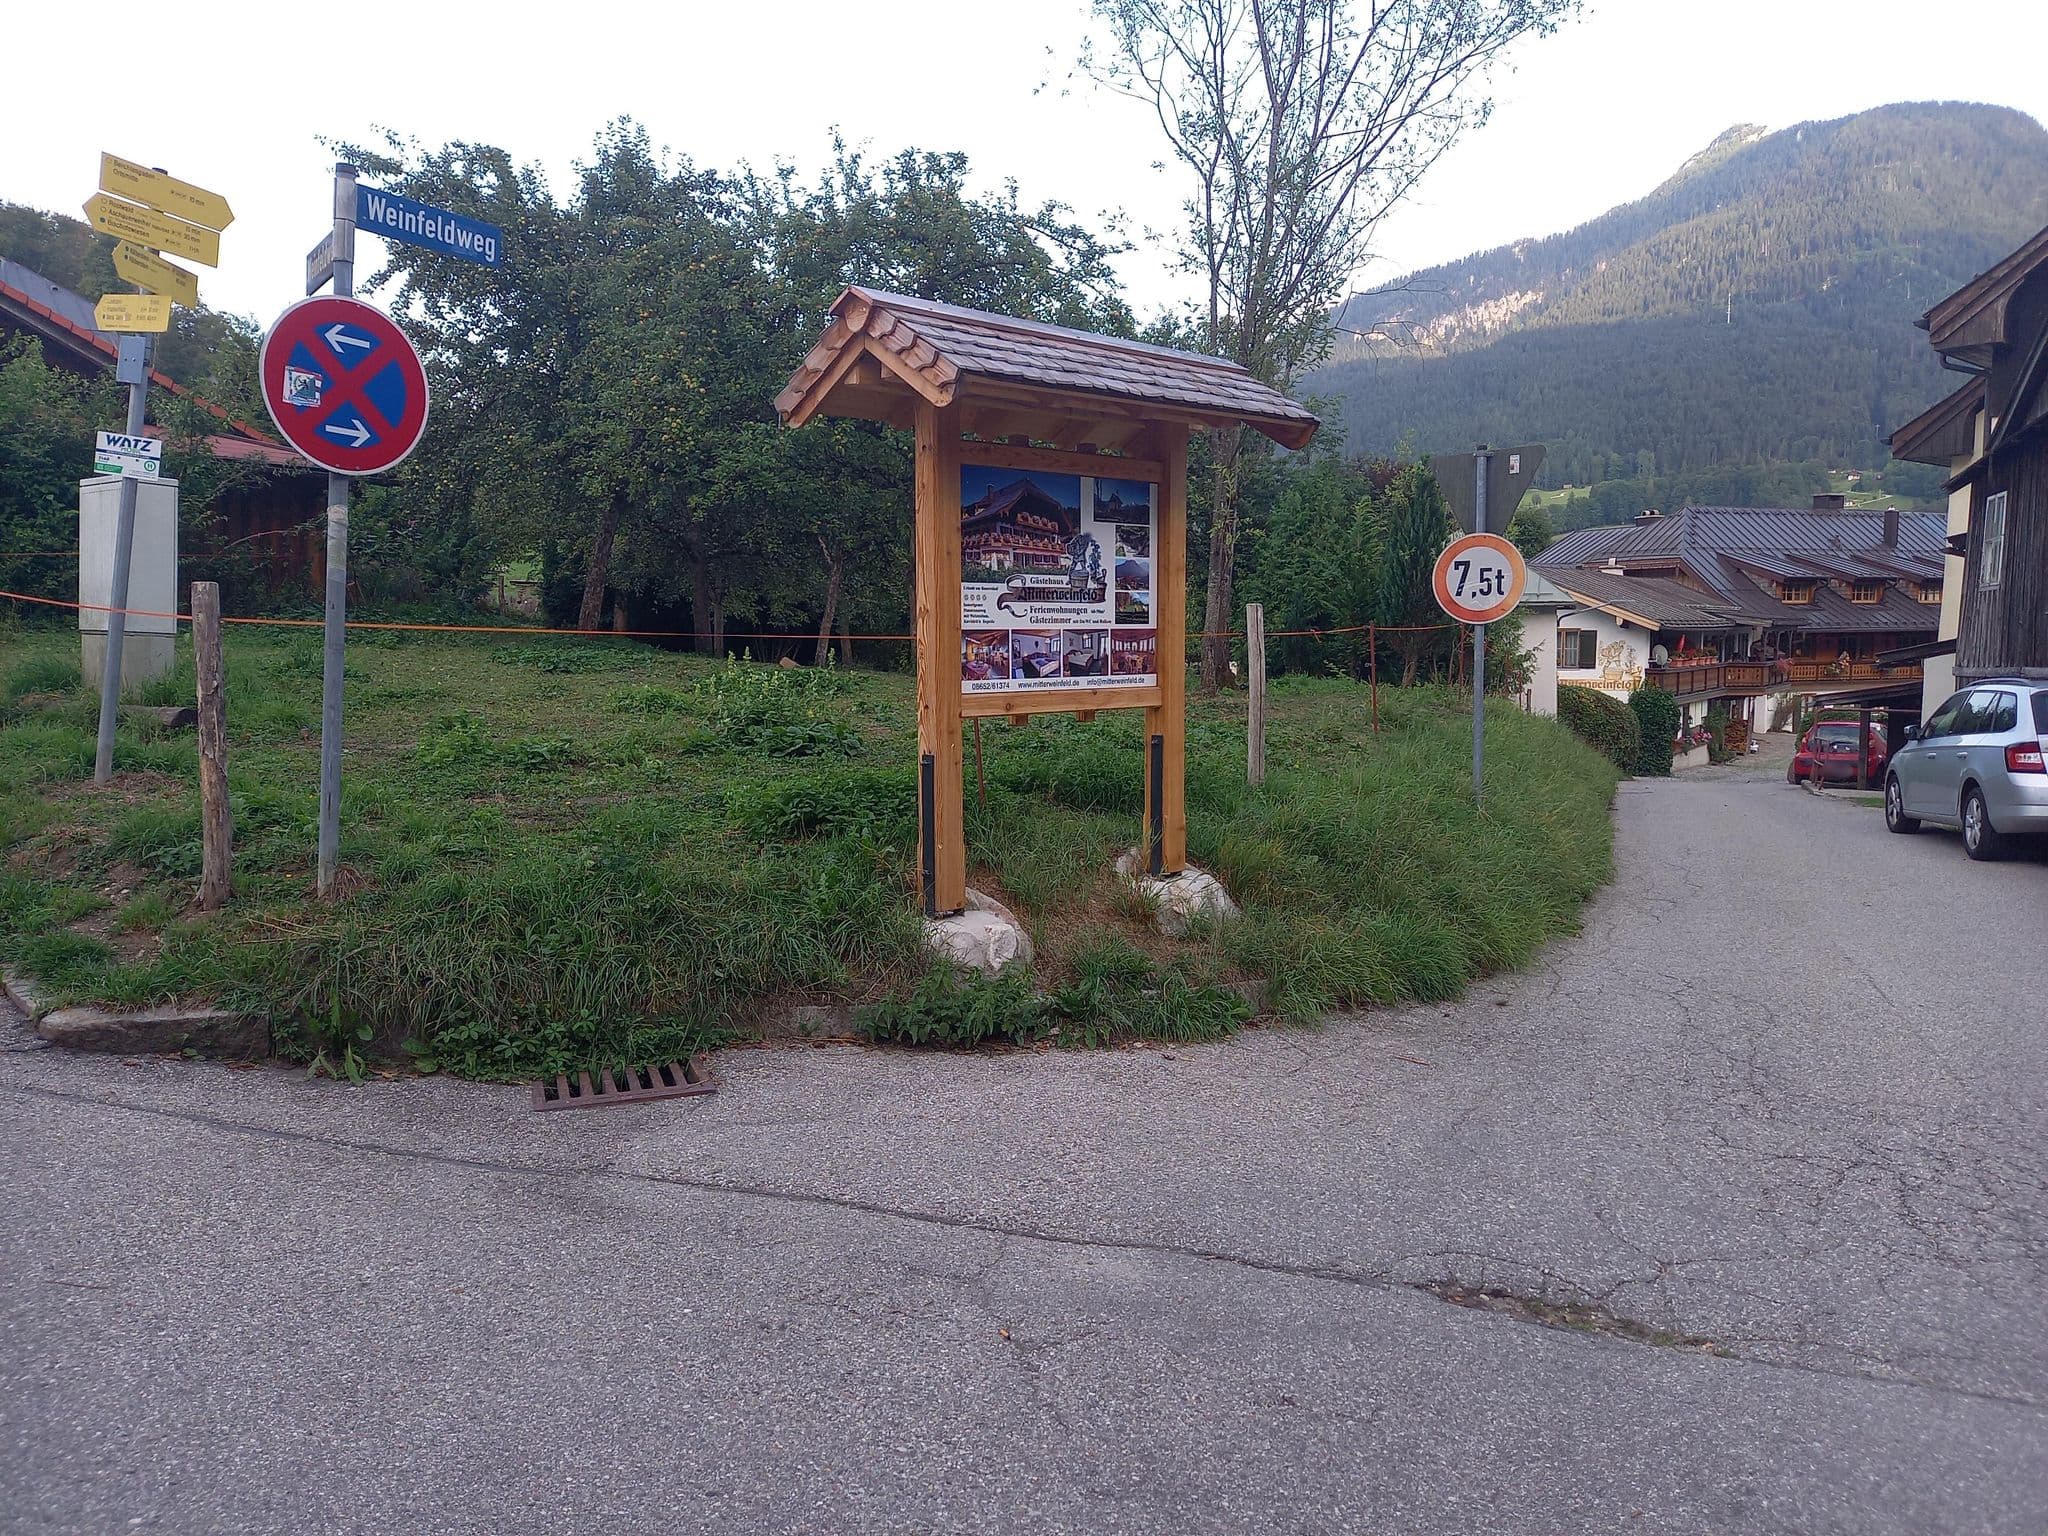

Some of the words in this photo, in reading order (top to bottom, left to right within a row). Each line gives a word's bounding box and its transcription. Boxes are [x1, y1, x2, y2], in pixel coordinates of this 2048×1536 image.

[367, 193, 496, 263] Weinfeldweg
[106, 434, 153, 452] WATZ
[1030, 576, 1065, 585] Gästehaus
[1454, 560, 1505, 599] 7,5t
[1029, 605, 1088, 615] Ferienwohnungen
[1029, 615, 1071, 624] Gästezimmer
